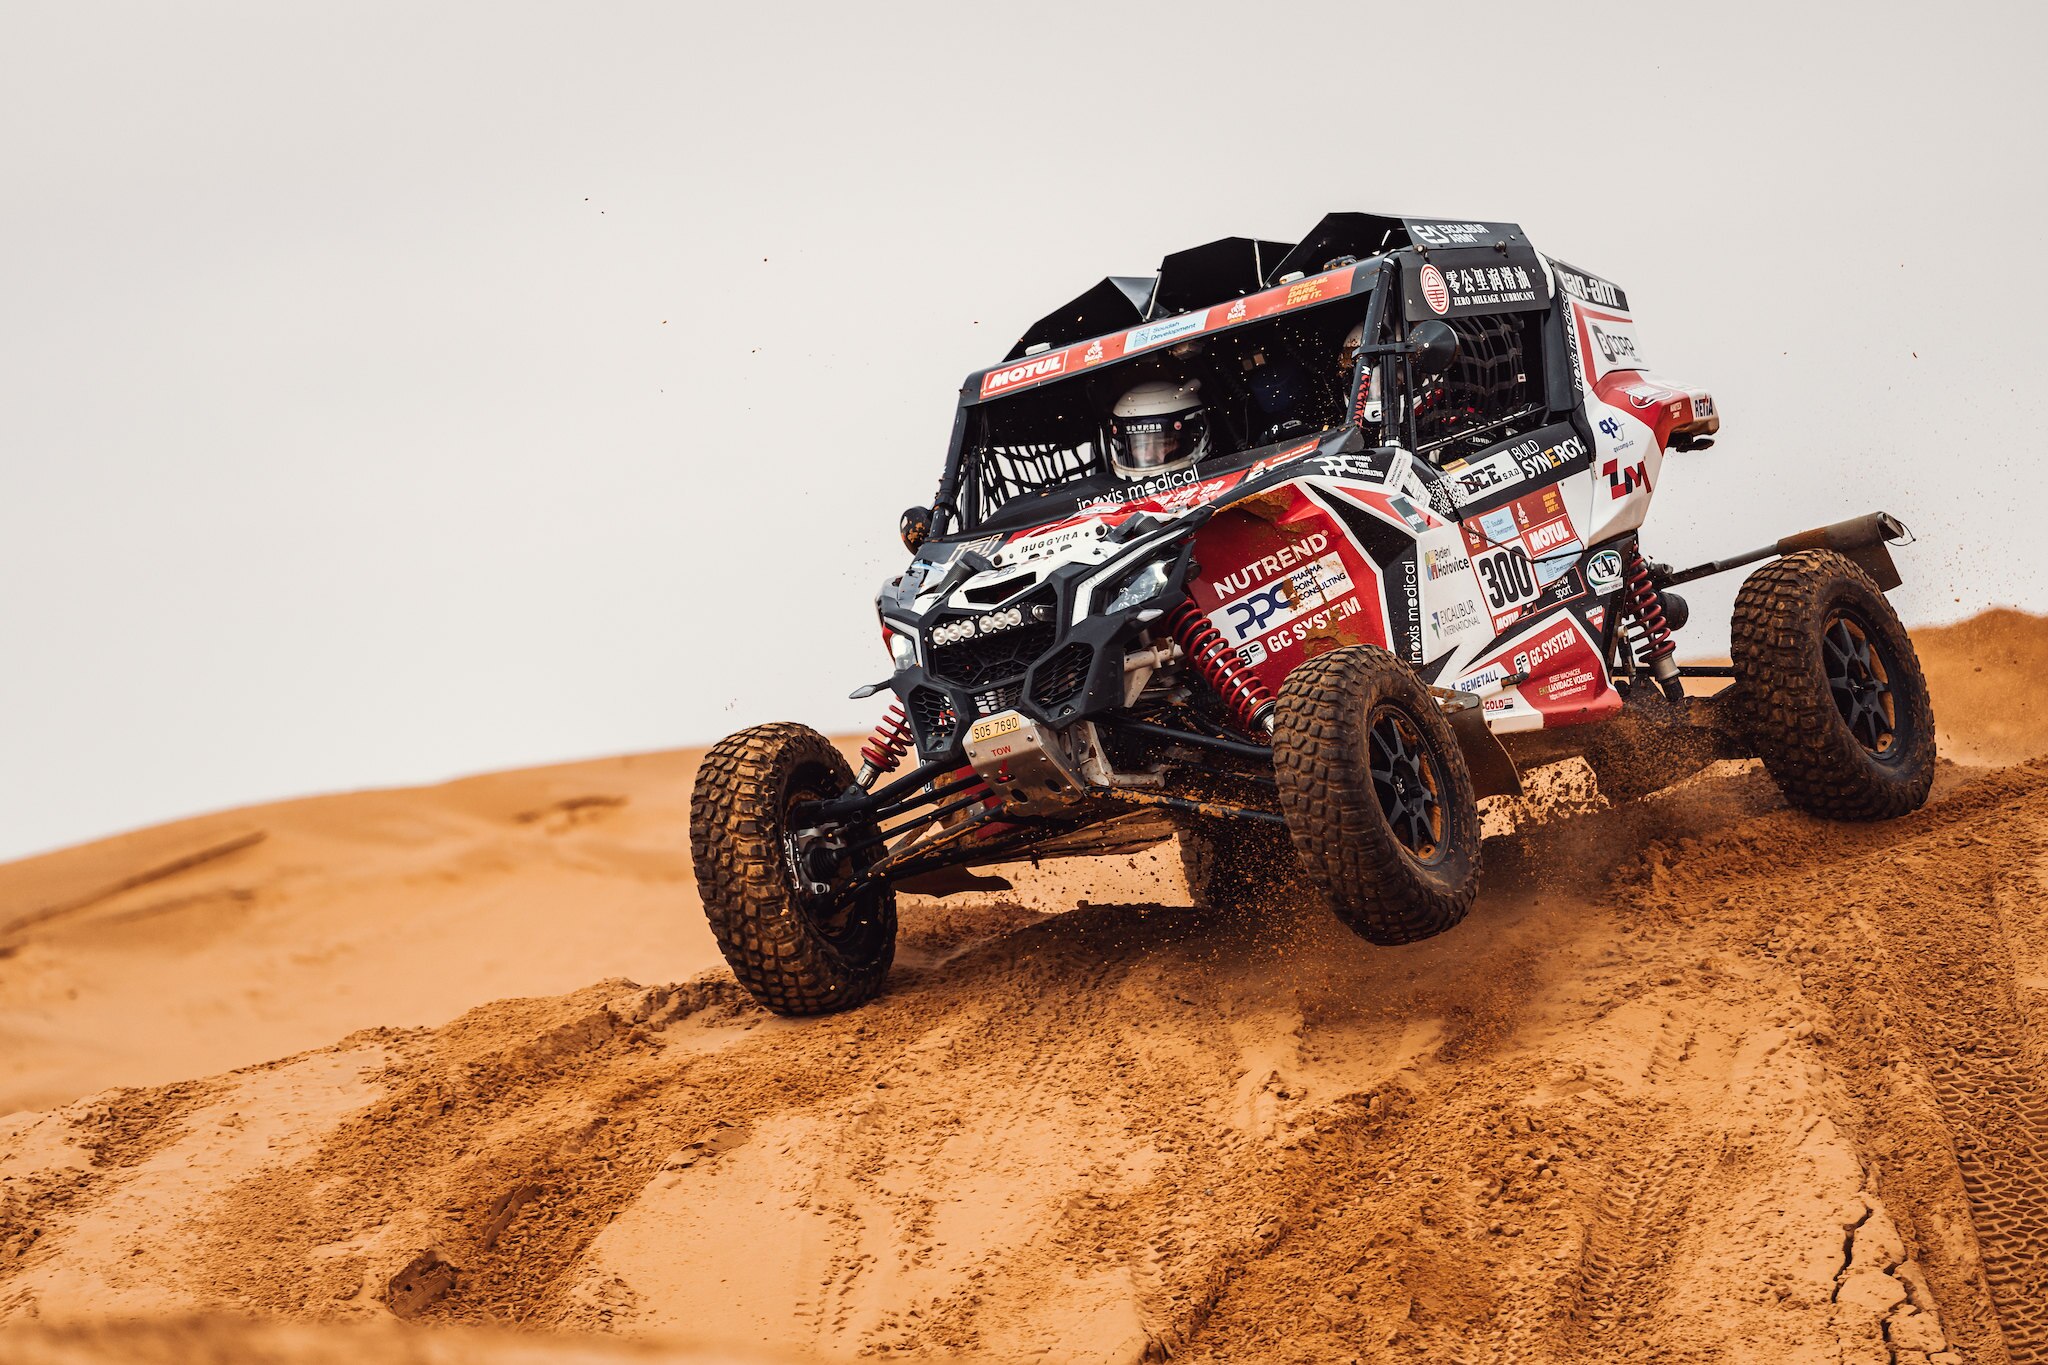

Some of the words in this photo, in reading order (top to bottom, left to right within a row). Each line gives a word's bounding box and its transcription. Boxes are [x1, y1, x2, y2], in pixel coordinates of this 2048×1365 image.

[1445, 266, 1532, 294] 零公里润滑油
[1453, 296, 1471, 306] ZERO
[1472, 293, 1500, 305] MILEAGE
[1500, 291, 1536, 303] LUBRICANT
[988, 356, 1062, 389] MOTUL
[1511, 440, 1540, 461] BUILD
[1021, 531, 1079, 554] BUGGYRA
[1528, 520, 1571, 551] MOTUL
[1213, 533, 1328, 600] NUTREND
[1289, 564, 1323, 582] PHARMA
[1479, 546, 1534, 609] 300
[1591, 553, 1618, 580] VAF
[1299, 572, 1346, 601] CONSULTING
[1555, 585, 1573, 600] sport
[1440, 600, 1476, 625] EXCALIBUR
[1443, 615, 1480, 637] INTERNATIONAL
[1267, 630, 1293, 653] GC
[1530, 648, 1543, 666] GC
[1541, 628, 1577, 657] SYSTEM
[1485, 699, 1504, 711] GOLD
[994, 717, 1018, 734] 7690
[991, 745, 1012, 757] TOW
